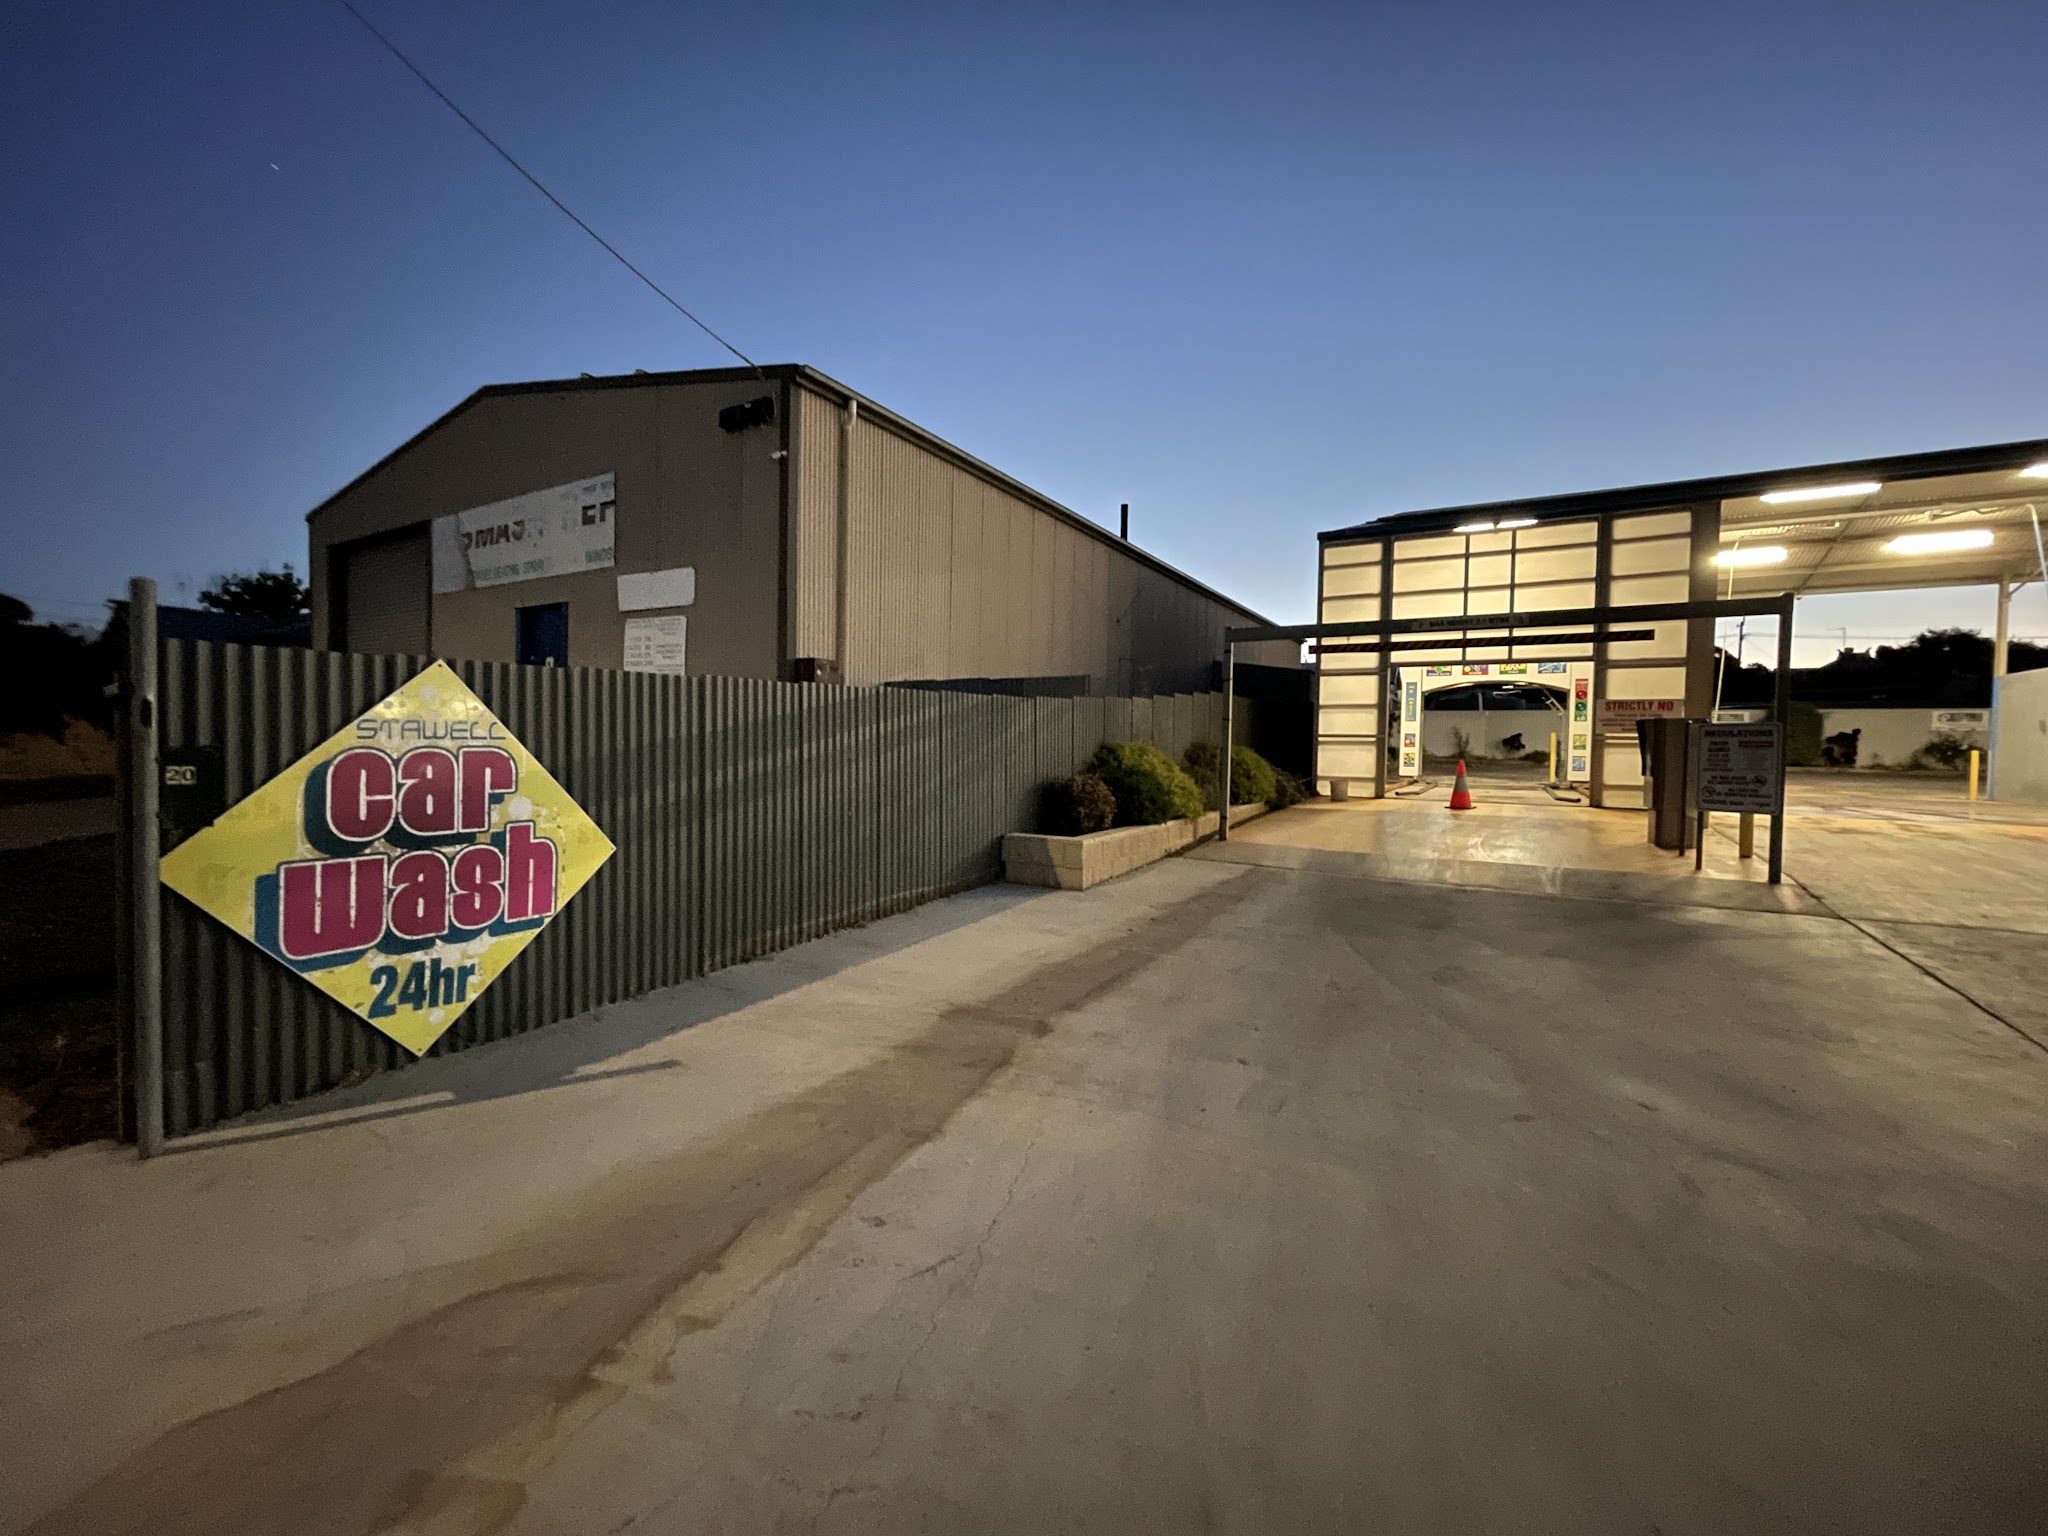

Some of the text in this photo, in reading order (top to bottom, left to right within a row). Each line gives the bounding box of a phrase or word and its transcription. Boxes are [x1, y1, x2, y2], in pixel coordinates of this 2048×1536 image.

[1605, 701, 1674, 712] STRICTLY NO
[356, 718, 507, 740] STAWELL
[166, 767, 195, 784] 20
[324, 745, 517, 842] car
[278, 821, 558, 961] wash
[367, 957, 476, 1020] 24hr
